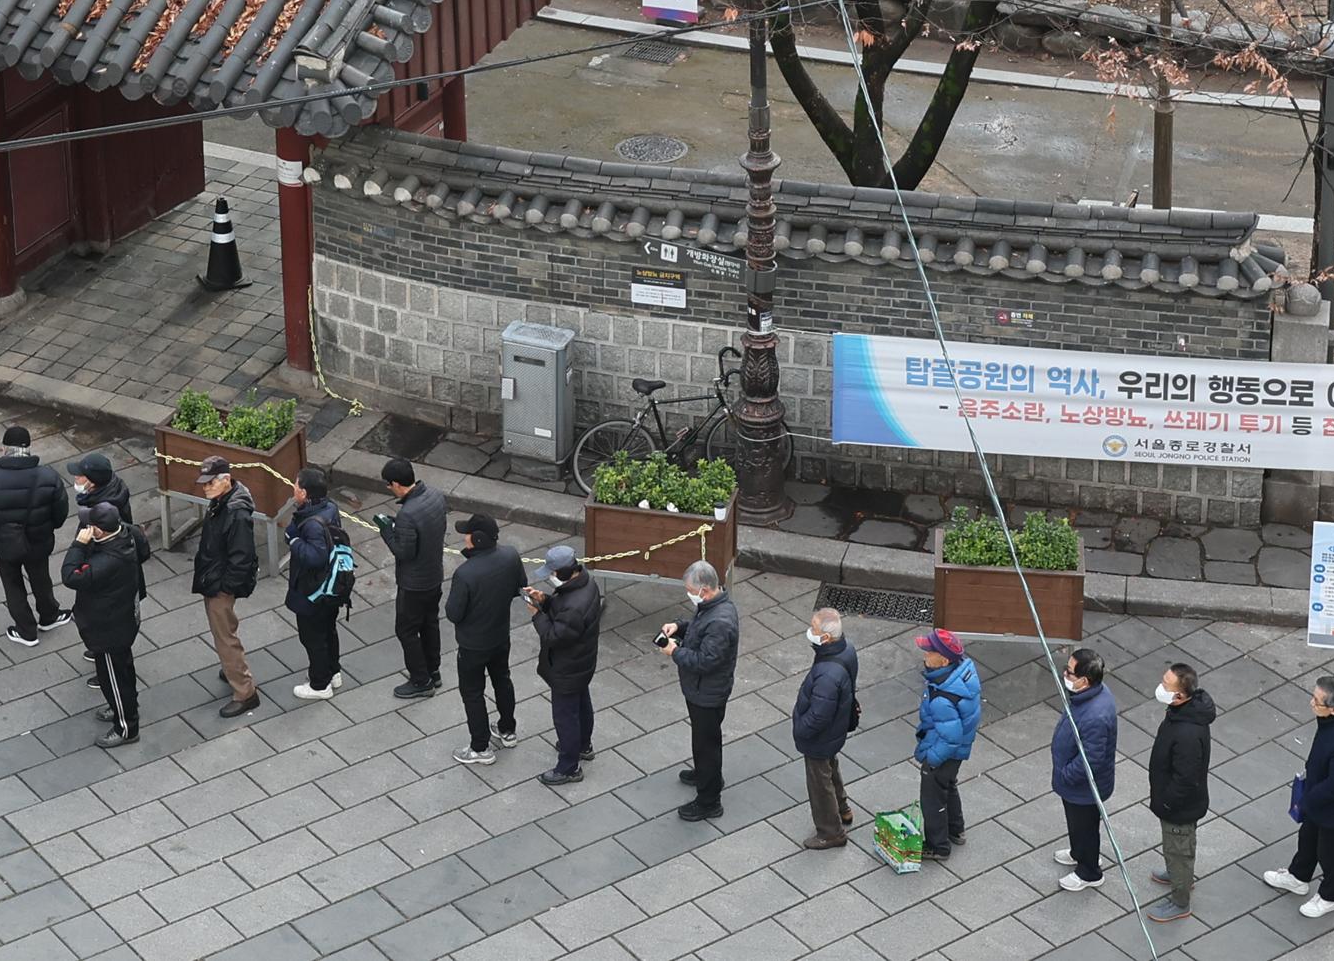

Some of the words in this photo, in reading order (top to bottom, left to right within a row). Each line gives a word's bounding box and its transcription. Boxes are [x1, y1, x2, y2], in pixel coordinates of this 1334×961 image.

[905, 356, 1035, 394] 탑골공원의
[1047, 366, 1106, 400] 역사,
[1117, 370, 1196, 402] 우리의
[1208, 374, 1315, 407] 행동으로
[957, 397, 1050, 424] 음주소란,
[1060, 405, 1154, 430] 노상방뇨,
[1163, 410, 1229, 432] 쓰레기
[1238, 414, 1282, 435] 투기
[1291, 416, 1313, 437] 등
[1134, 438, 1252, 455] 서울종로경찰서
[1134, 450, 1157, 459] SEOUL
[1158, 452, 1192, 461] JONGNO
[1193, 454, 1219, 462] POLICE
[1221, 455, 1251, 463] STATION
